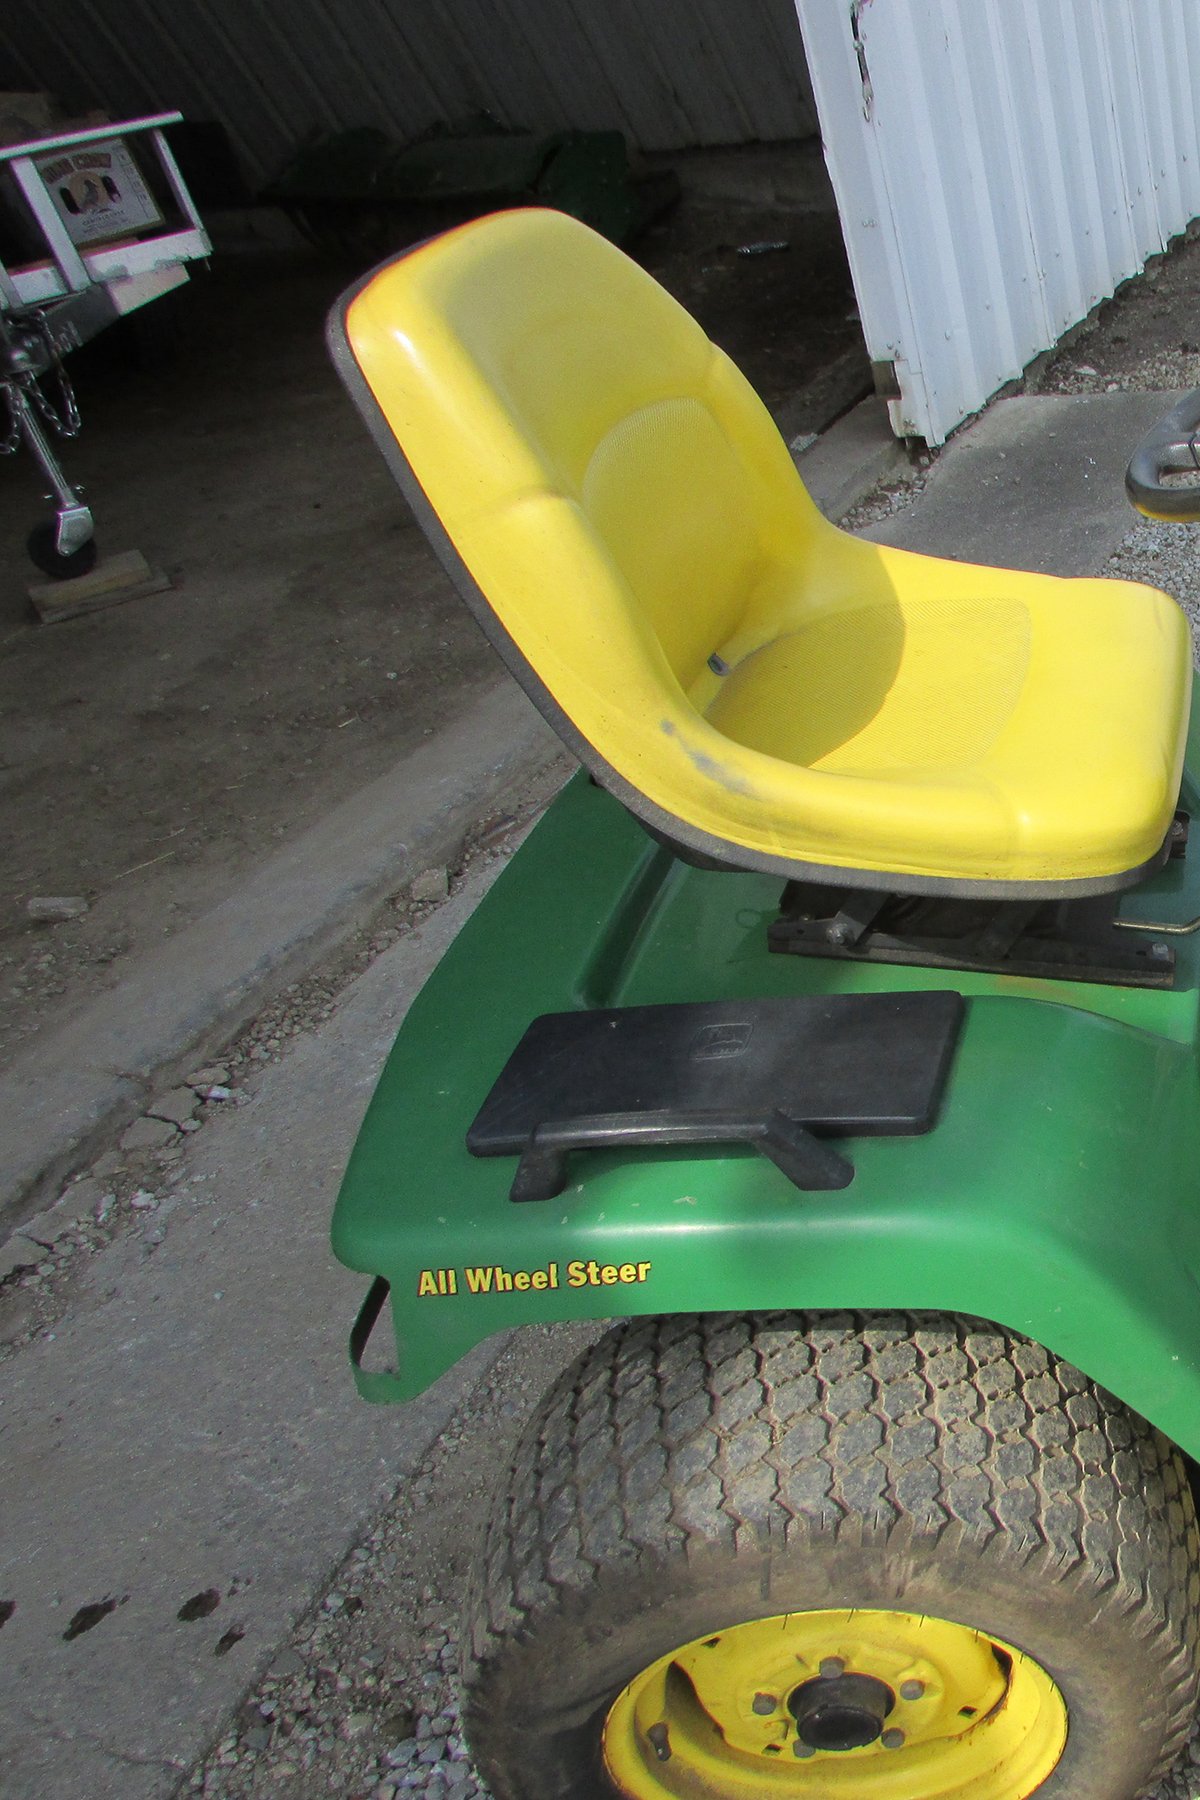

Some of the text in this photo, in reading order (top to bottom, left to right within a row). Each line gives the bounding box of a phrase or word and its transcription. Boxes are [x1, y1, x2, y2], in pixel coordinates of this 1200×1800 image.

[418, 1260, 652, 1297] All Wheel Steer
